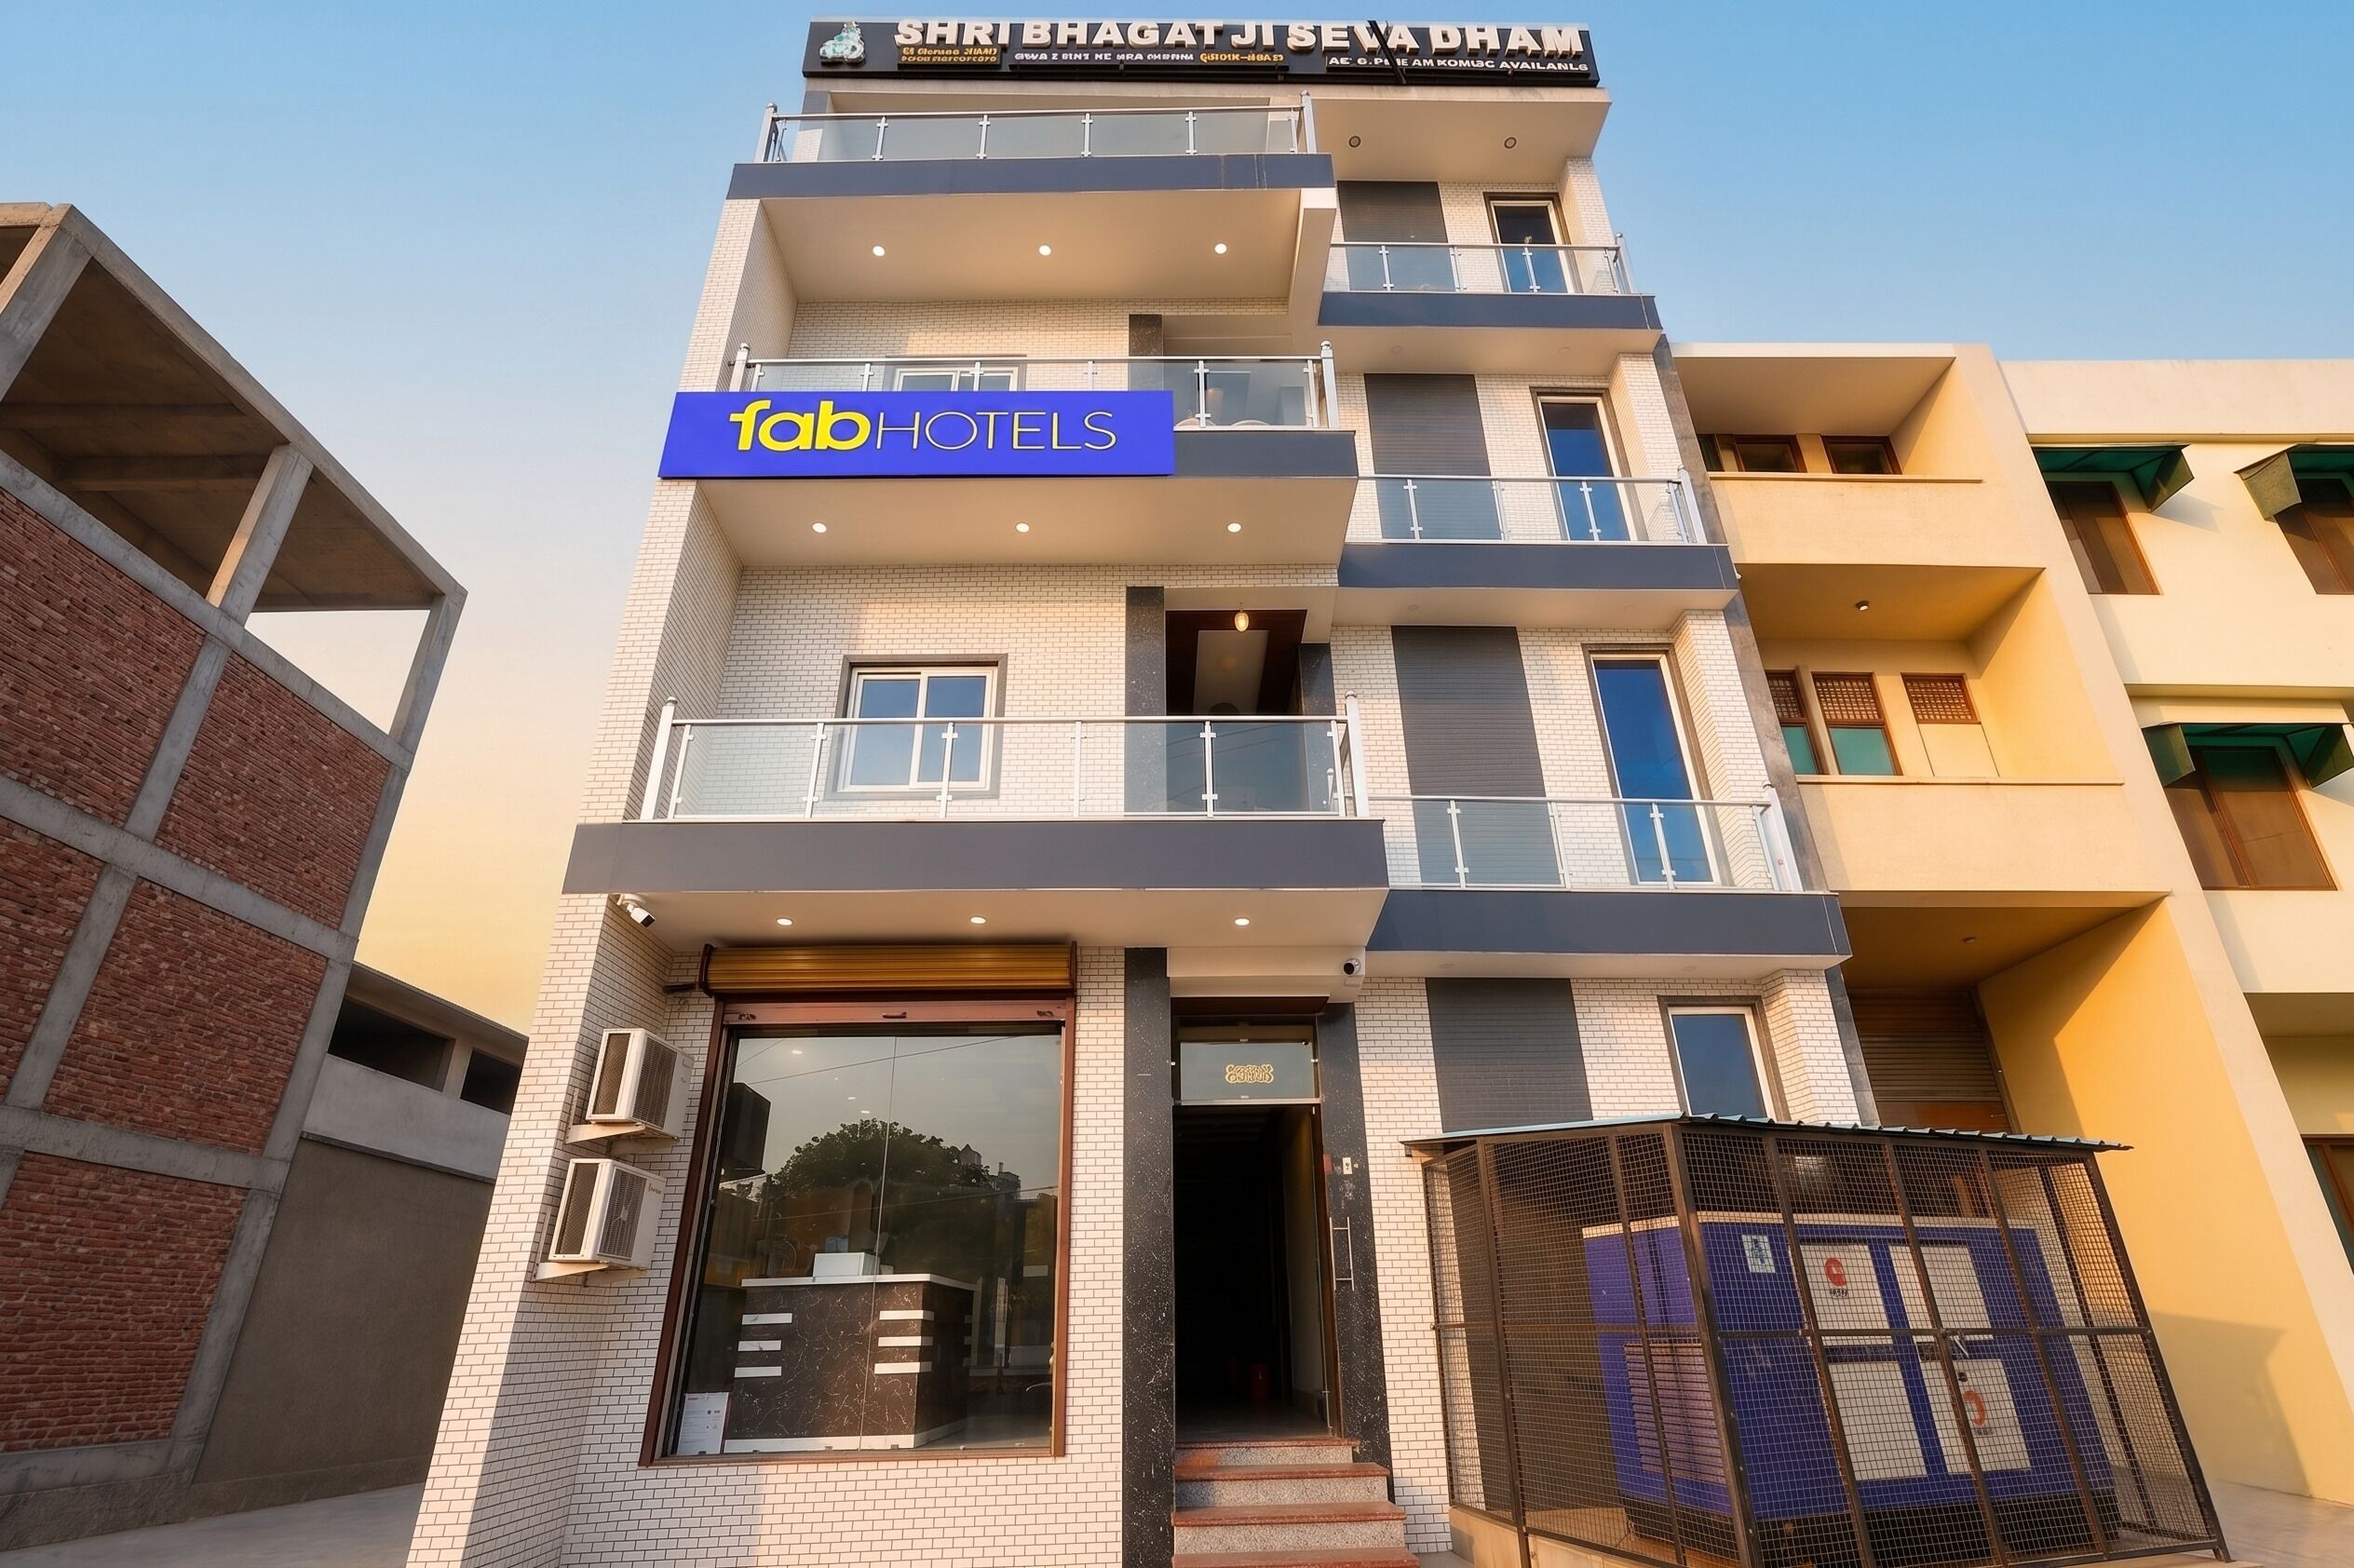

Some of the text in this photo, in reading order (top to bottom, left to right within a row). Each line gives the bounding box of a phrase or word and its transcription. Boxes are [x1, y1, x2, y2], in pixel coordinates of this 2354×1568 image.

[894, 19, 1585, 57] SHRI BHAGAT JI SEVA DHAM
